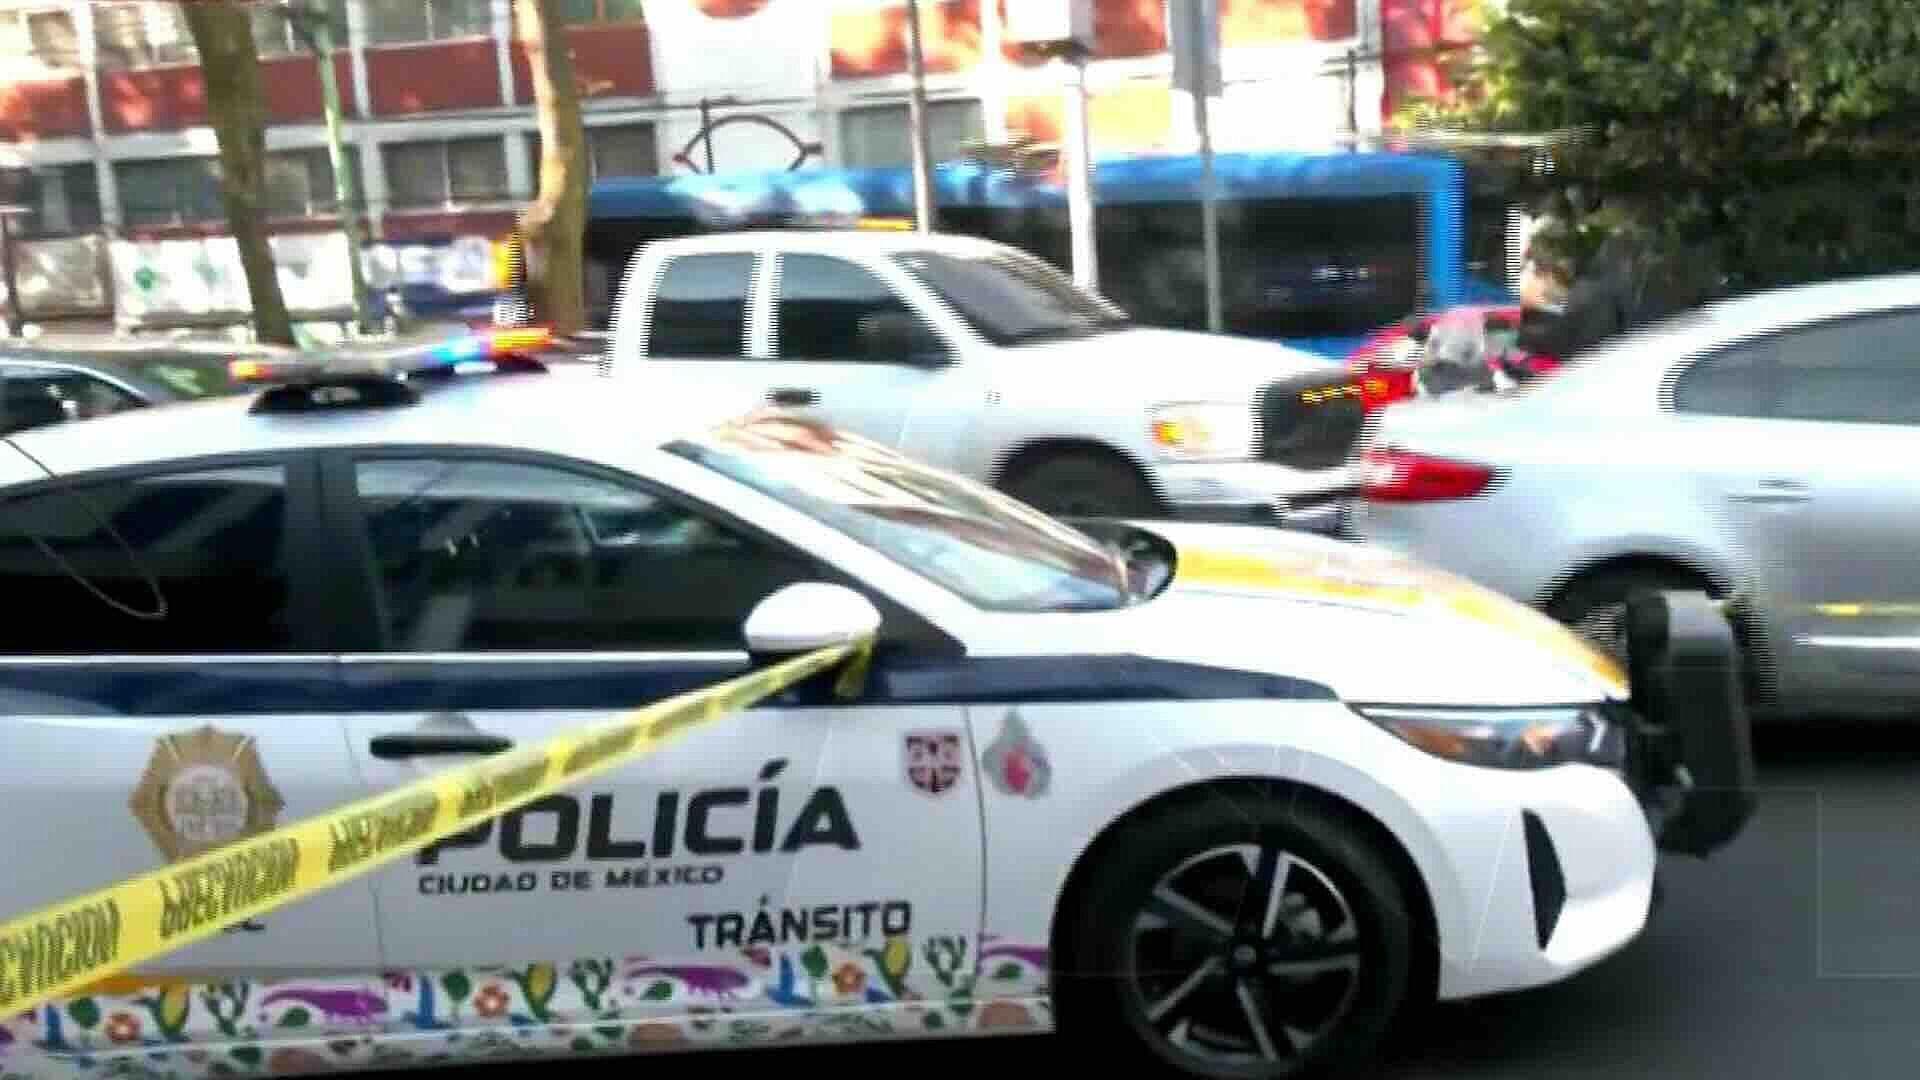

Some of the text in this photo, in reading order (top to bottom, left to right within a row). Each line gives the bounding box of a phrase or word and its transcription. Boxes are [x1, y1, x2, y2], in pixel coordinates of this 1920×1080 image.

[418, 871, 537, 895] CIUDAD
[551, 870, 592, 891] DE
[686, 892, 912, 949] TRÁNSITO
